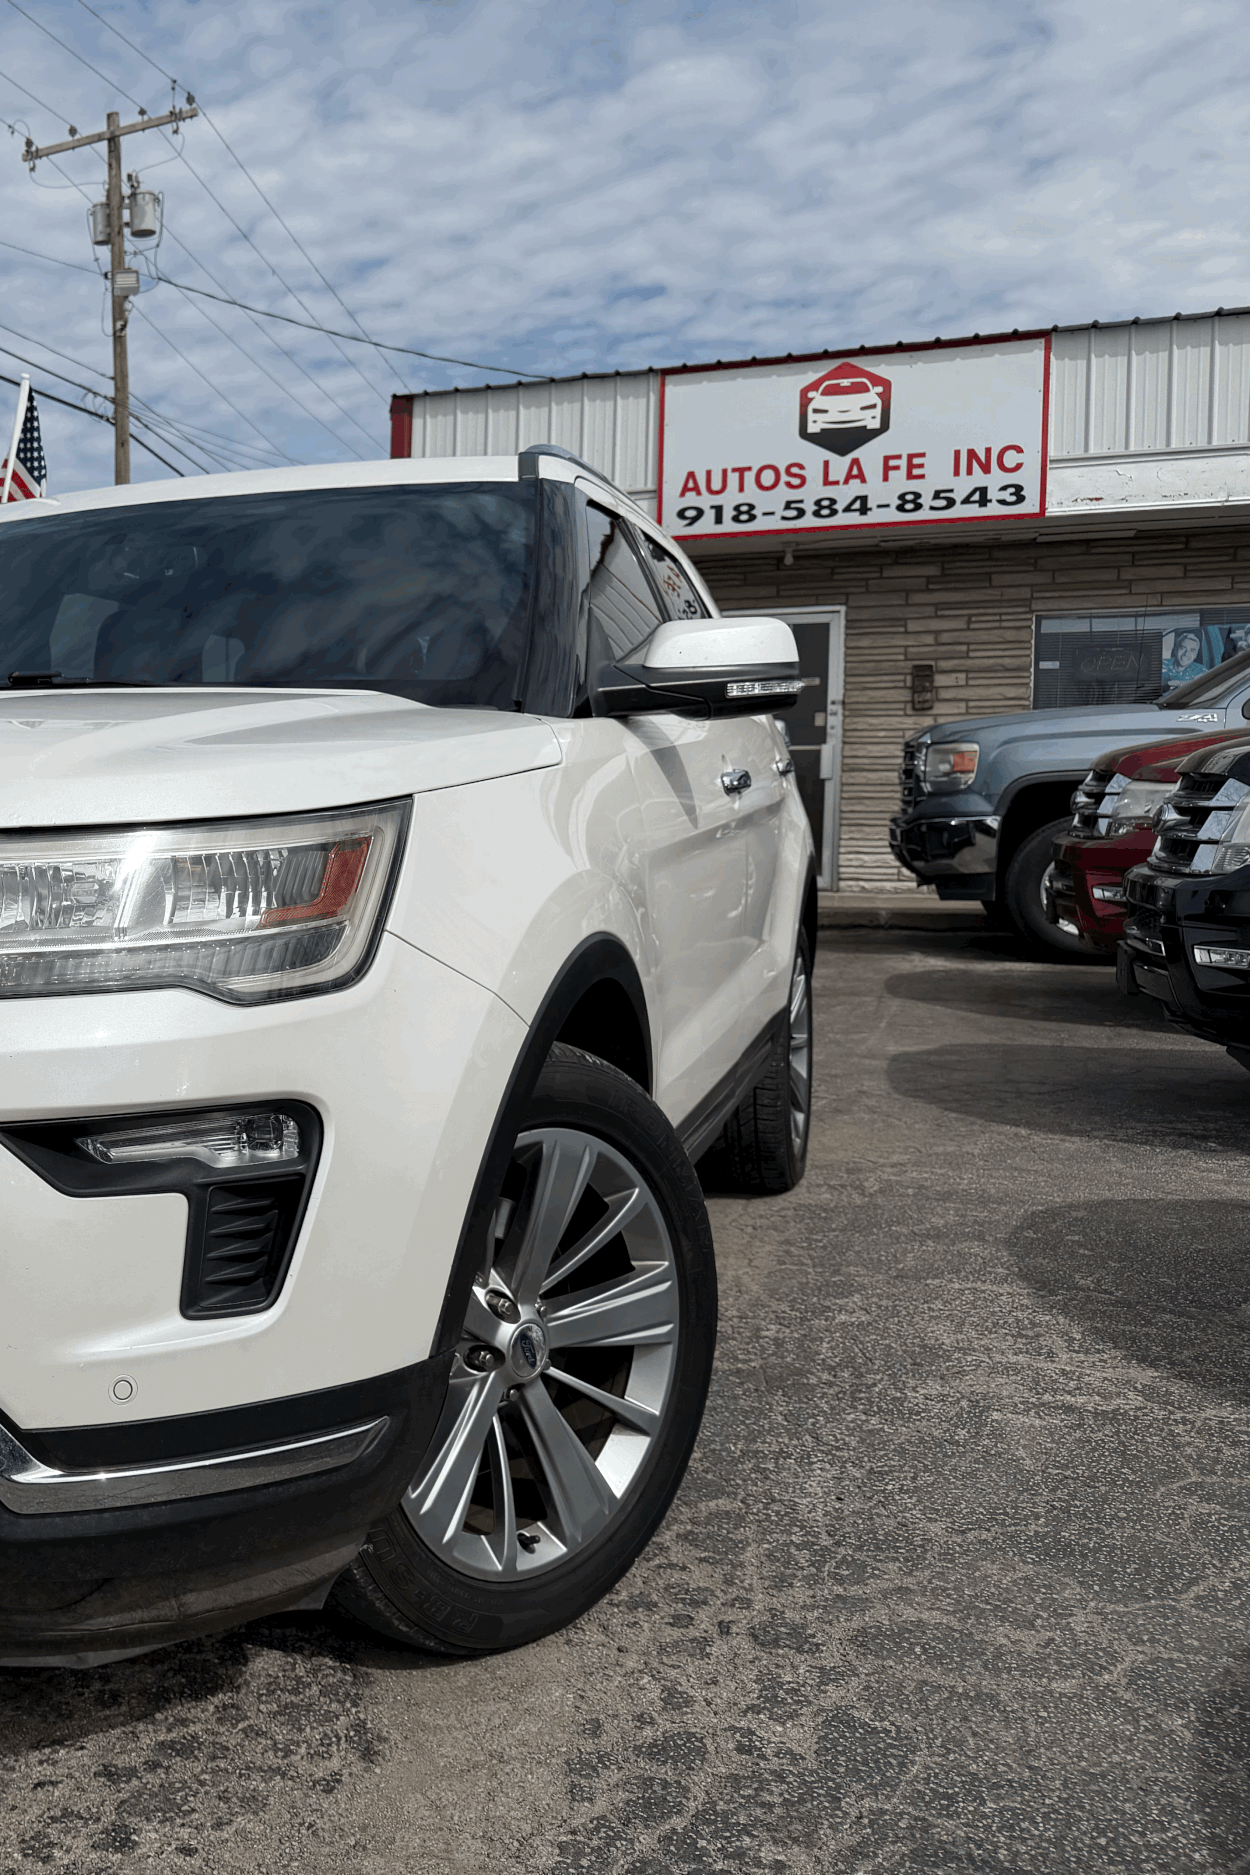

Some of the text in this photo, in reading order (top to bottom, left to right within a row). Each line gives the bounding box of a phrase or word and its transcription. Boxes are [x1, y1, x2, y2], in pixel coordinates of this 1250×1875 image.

[679, 444, 1025, 498] AUTOS LA FE INC
[676, 484, 1026, 527] 918-584-8543
[1080, 652, 1145, 673] OPEN
[362, 1527, 479, 1635] RB-SU
